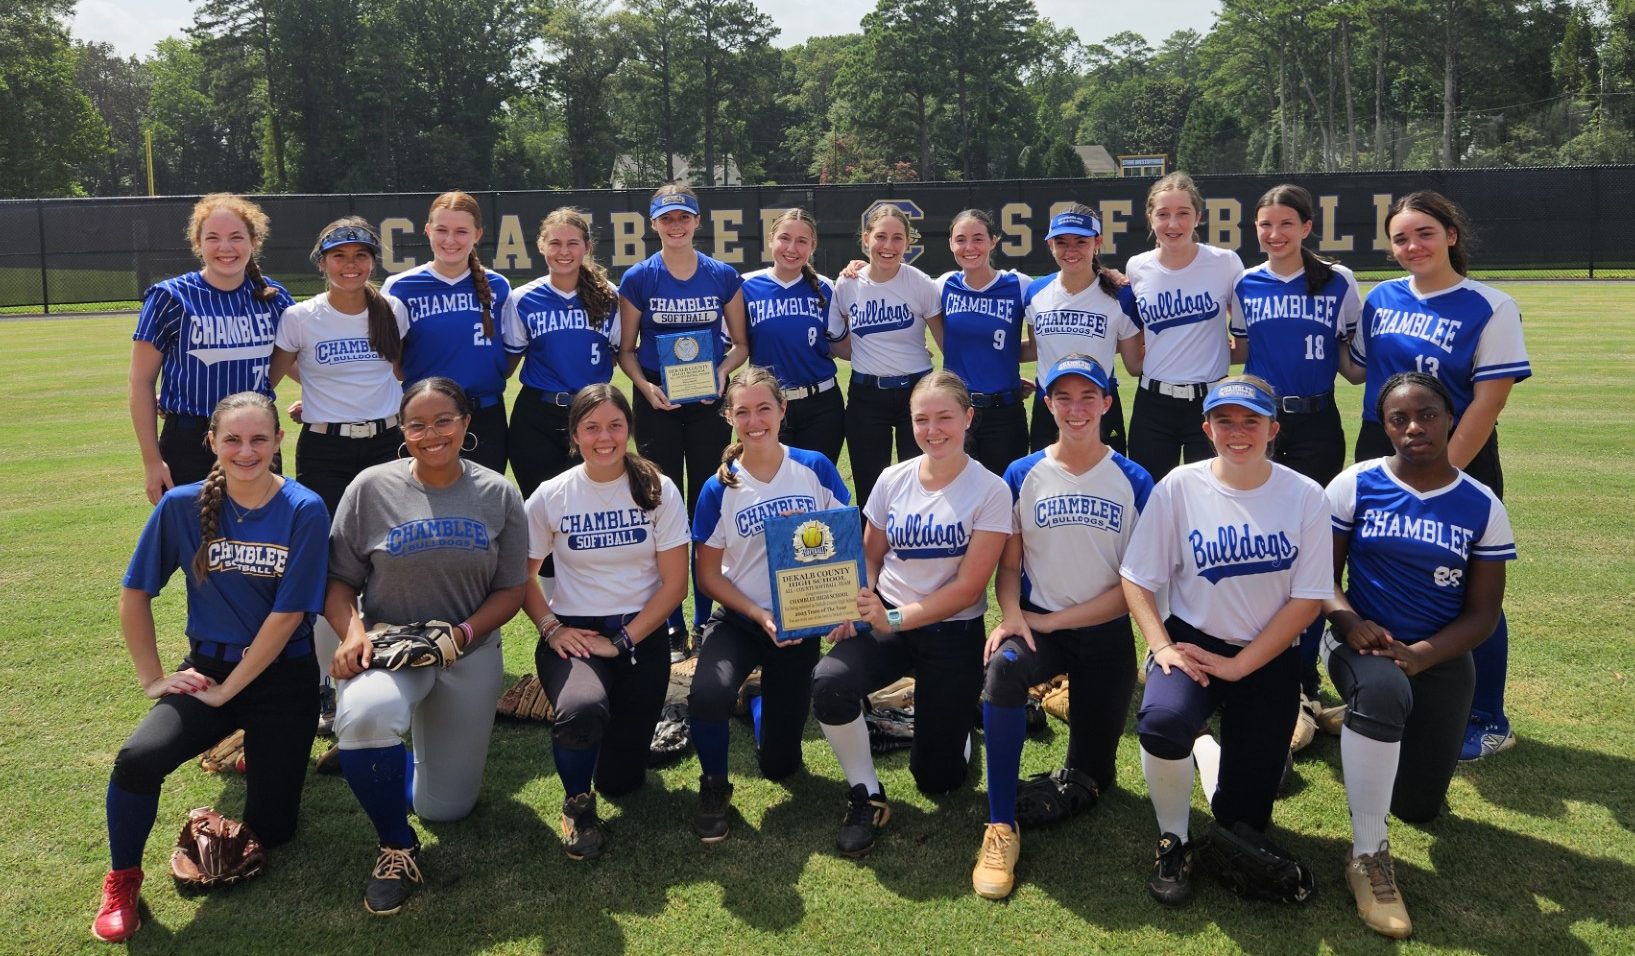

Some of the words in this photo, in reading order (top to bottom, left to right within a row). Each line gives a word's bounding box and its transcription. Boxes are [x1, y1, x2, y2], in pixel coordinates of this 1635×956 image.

[649, 295, 720, 312] CHAMBLEE
[850, 298, 909, 327] Bulldogs
[945, 292, 1014, 324] CHAMBLEE
[1137, 288, 1214, 323] Bulldogs
[1243, 295, 1337, 328] CHAMBLEE
[191, 312, 275, 345] CHAMBLEE
[661, 313, 710, 323] SOFTBALL
[1035, 312, 1105, 334] CHAMBLEE
[807, 326, 818, 347] 8
[993, 329, 1006, 350] 9
[1370, 308, 1462, 354] CHAMBLEE
[318, 340, 377, 361] CHAMB
[590, 343, 601, 366] 5
[1304, 334, 1324, 360] 18
[561, 508, 650, 533] CHAMBLEE
[1037, 498, 1120, 528] CHAMBLEE
[1052, 516, 1104, 526] BULLDOGS
[389, 520, 487, 553] CHAMBLEE
[576, 530, 637, 549] SOFTBALL
[887, 513, 966, 553] Bulldogs
[1361, 509, 1474, 562] CHAMBLEE
[1188, 523, 1291, 569] Bulldogs
[225, 560, 272, 574] SOTBALL
[782, 572, 815, 583] DEKALB
[816, 567, 851, 578] COUNTY
[788, 579, 811, 588] HIGH
[812, 575, 846, 585] SCHOOL
